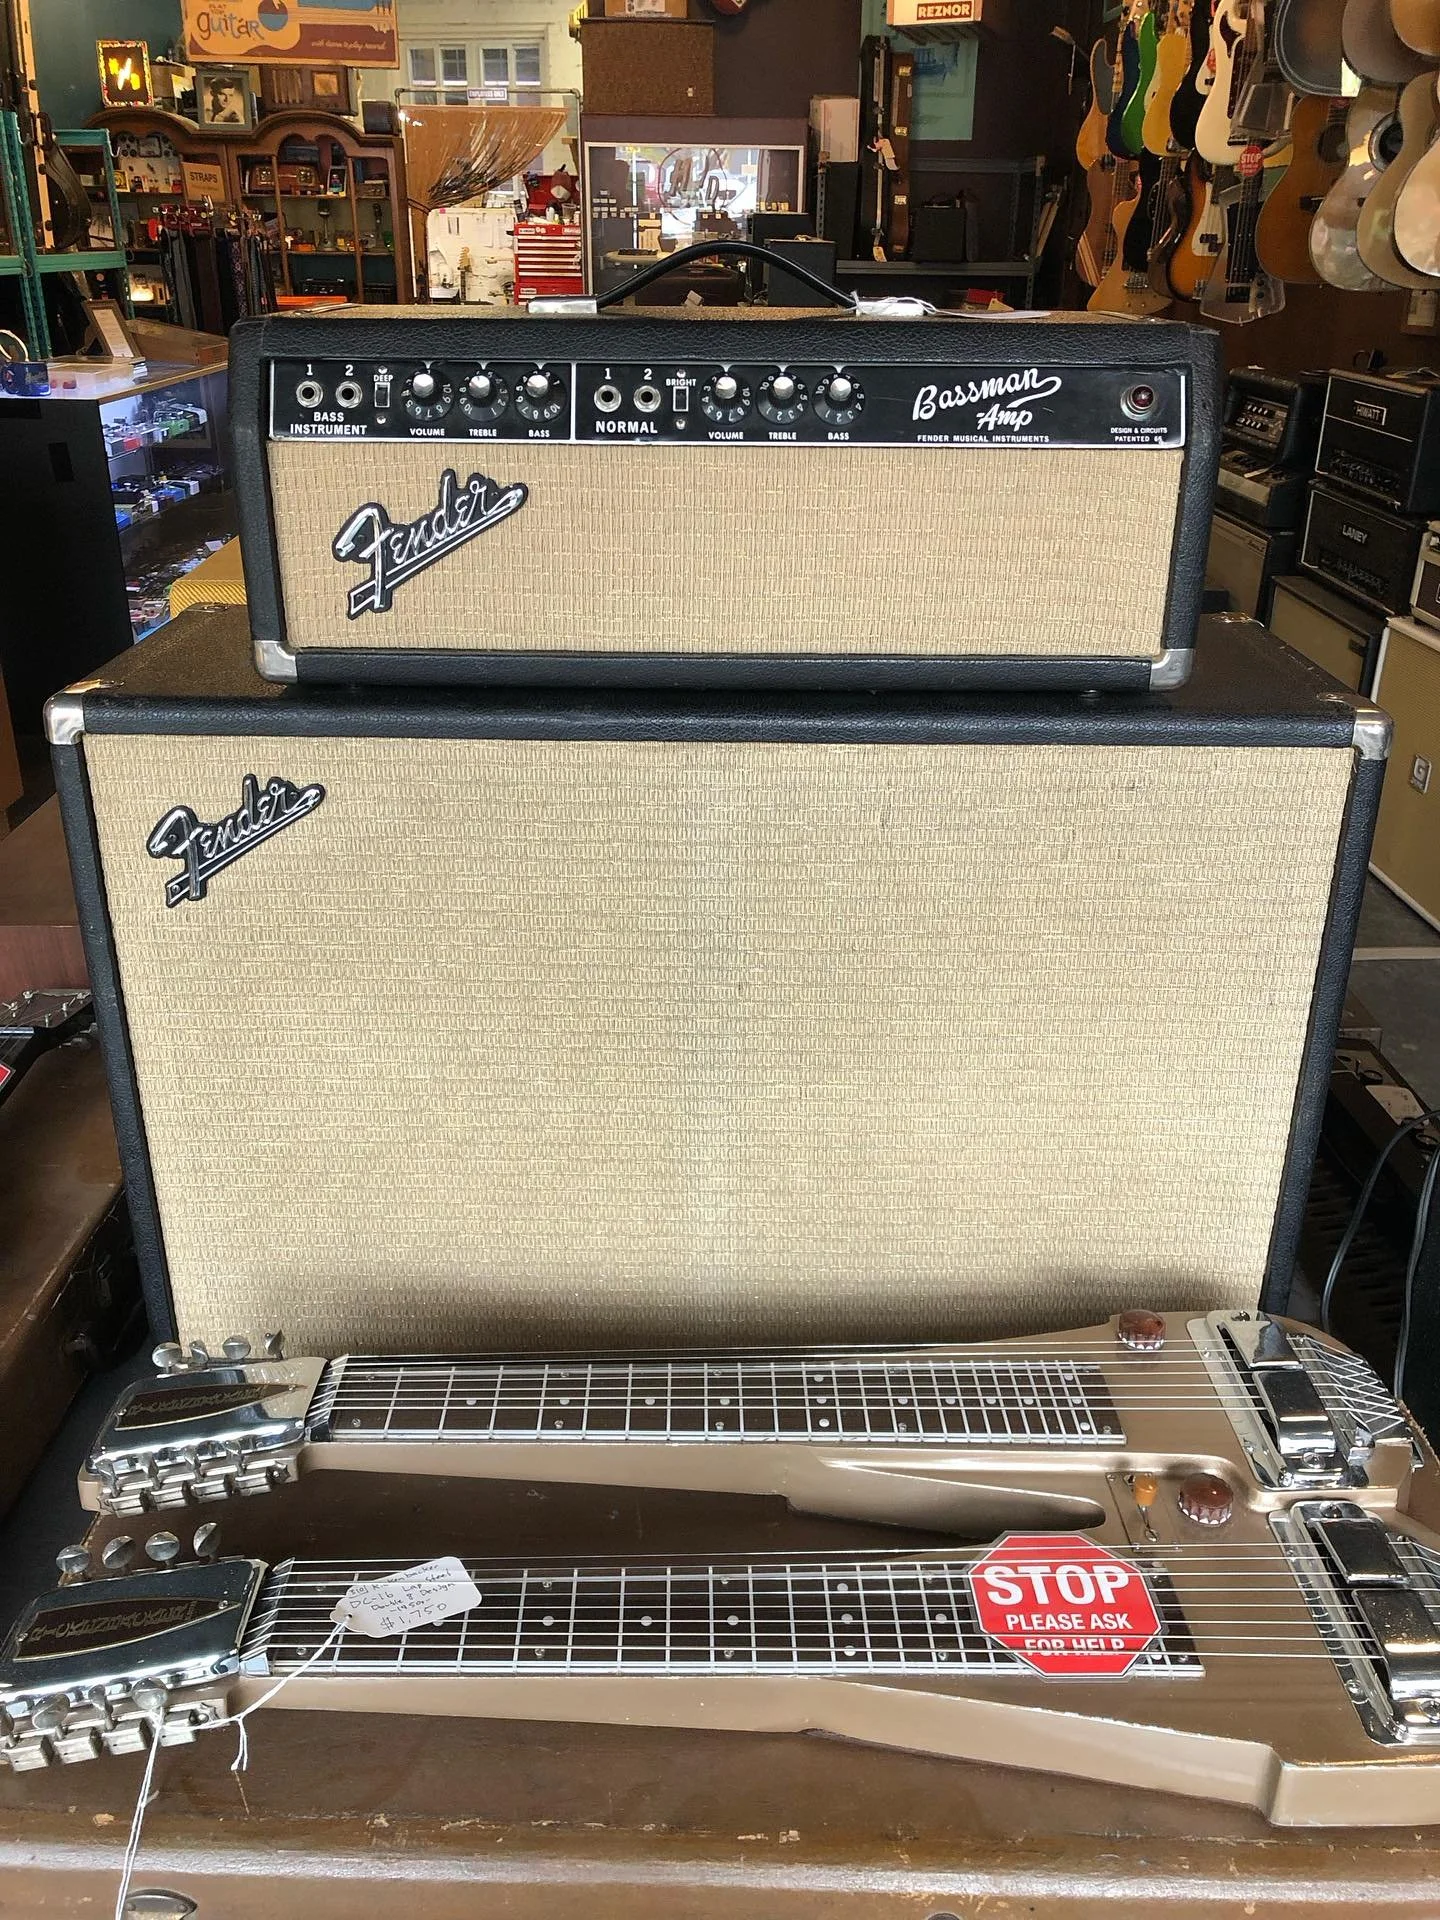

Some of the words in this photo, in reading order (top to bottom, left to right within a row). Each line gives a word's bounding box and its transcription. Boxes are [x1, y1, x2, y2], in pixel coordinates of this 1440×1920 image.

[918, 4, 970, 18] REZNOR
[1241, 153, 1261, 164] STOP
[189, 171, 218, 183] STRAPS
[306, 364, 313, 376] 1
[345, 364, 354, 376] 2
[604, 368, 612, 380] 1
[643, 368, 652, 380] 2
[373, 374, 394, 382] DEEP
[665, 378, 697, 387] BRIGHT
[912, 368, 1062, 421] Bassman
[313, 411, 345, 422] BASS
[976, 403, 1033, 432] Amp
[290, 424, 368, 435] INSTRUMENT
[410, 428, 445, 437] VOLUME
[469, 428, 497, 437] TREBLE
[595, 420, 658, 433] NORMAL
[528, 429, 550, 437] BASS
[708, 431, 744, 440] VOLUME
[768, 431, 797, 440] TREBLE
[827, 432, 850, 440] BASS
[917, 434, 950, 442] FENDER
[992, 435, 1050, 443] INSTRUMENTS
[1341, 523, 1368, 545] LANEY
[334, 471, 525, 617] Fender
[148, 776, 323, 905] Fender
[983, 1564, 1129, 1606] STOP
[380, 1603, 447, 1631] $1,750
[1006, 1613, 1086, 1631] PLEASE
[1090, 1613, 1133, 1630] ASK
[1024, 1638, 1065, 1657] FOR
[1072, 1638, 1126, 1657] HELP
